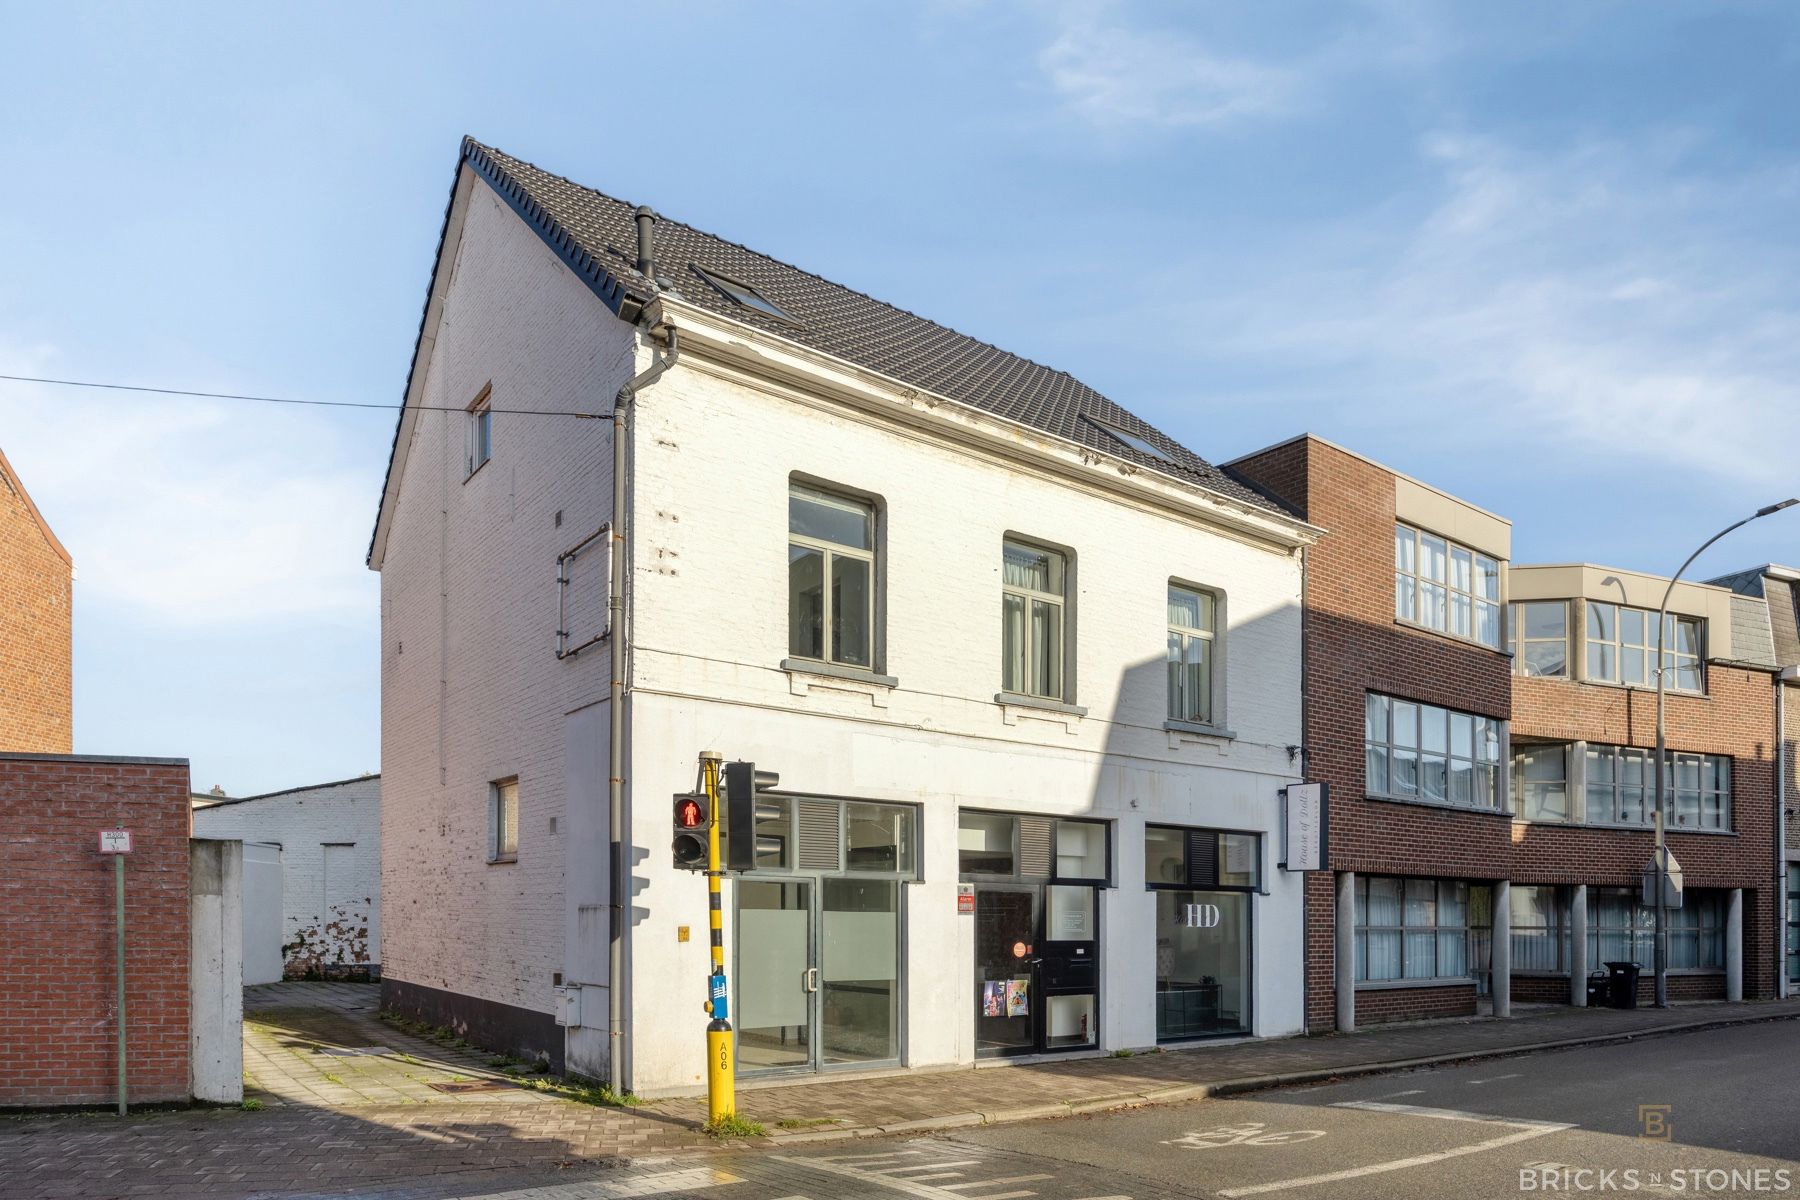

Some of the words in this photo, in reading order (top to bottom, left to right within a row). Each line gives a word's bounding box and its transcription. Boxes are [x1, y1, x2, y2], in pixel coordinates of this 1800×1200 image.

[1299, 820, 1310, 832] of
[1299, 835, 1309, 864] House
[1186, 904, 1220, 928] HD
[720, 1042, 728, 1069] A06
